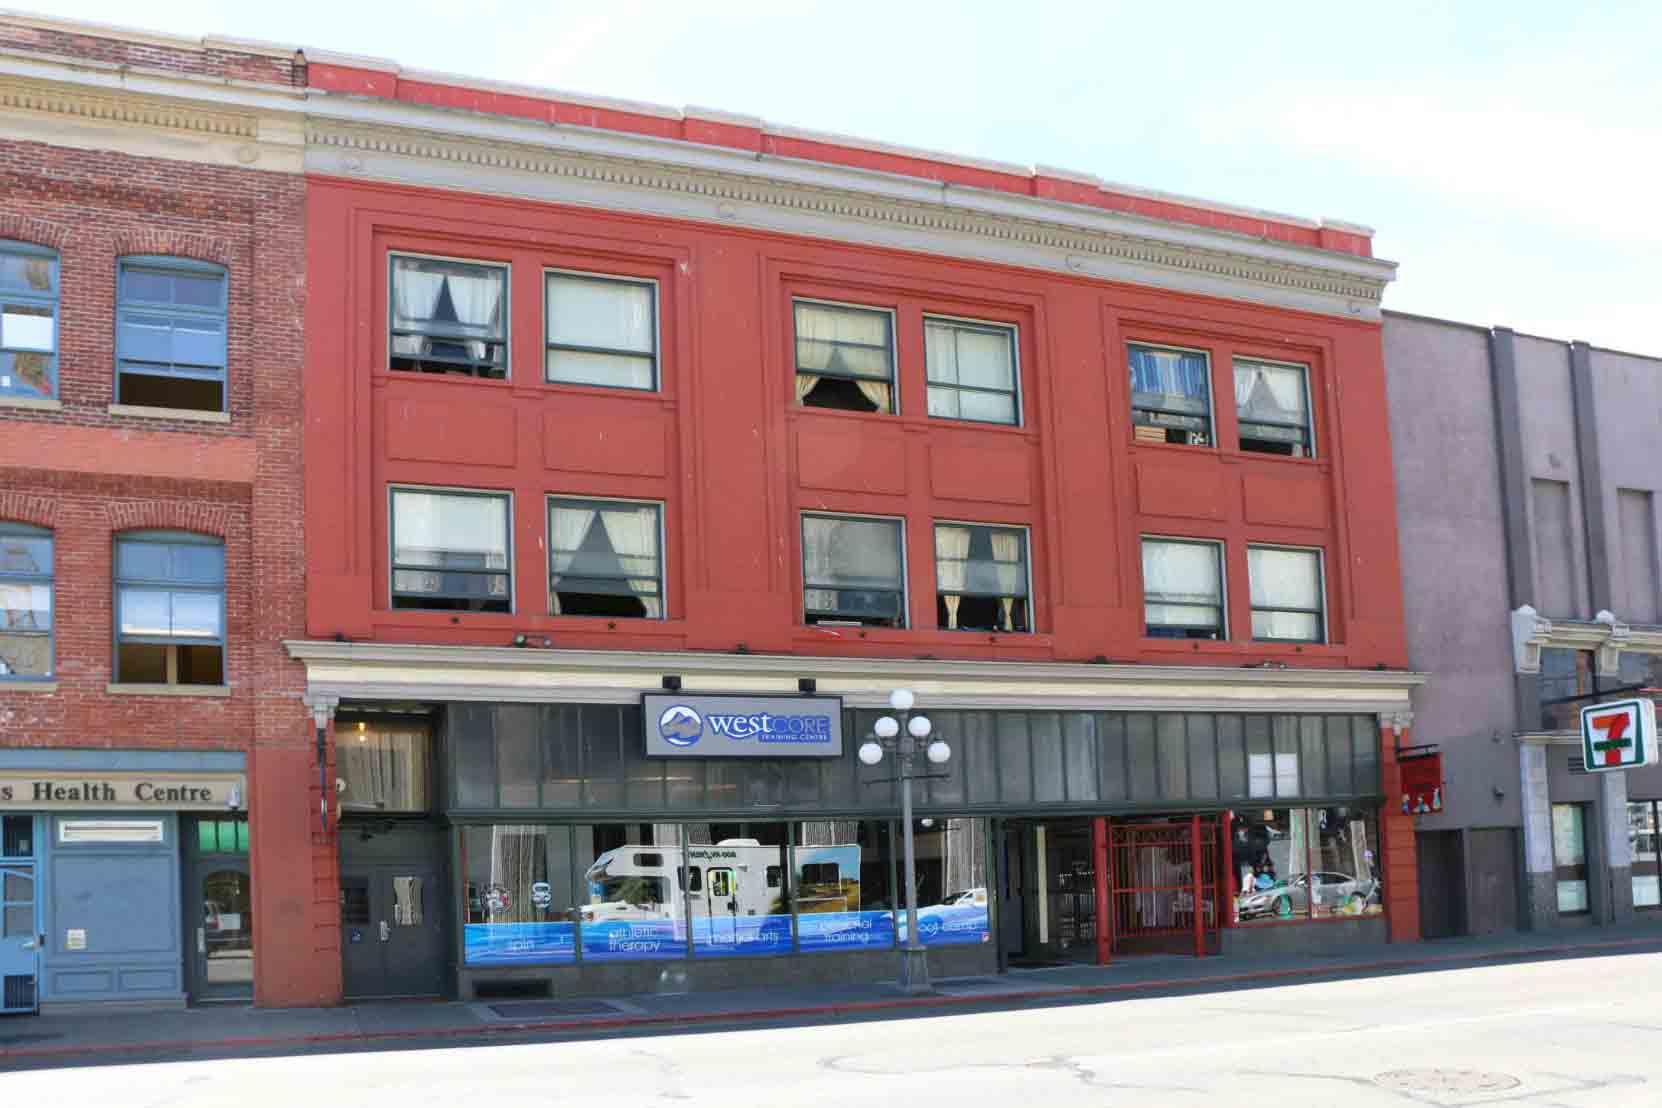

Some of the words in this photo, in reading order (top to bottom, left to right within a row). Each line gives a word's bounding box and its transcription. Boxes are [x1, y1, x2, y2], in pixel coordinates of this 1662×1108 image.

[1592, 712, 1630, 766] 7
[32, 781, 116, 801] Health
[135, 782, 212, 801] Centre
[608, 938, 661, 953] therapy
